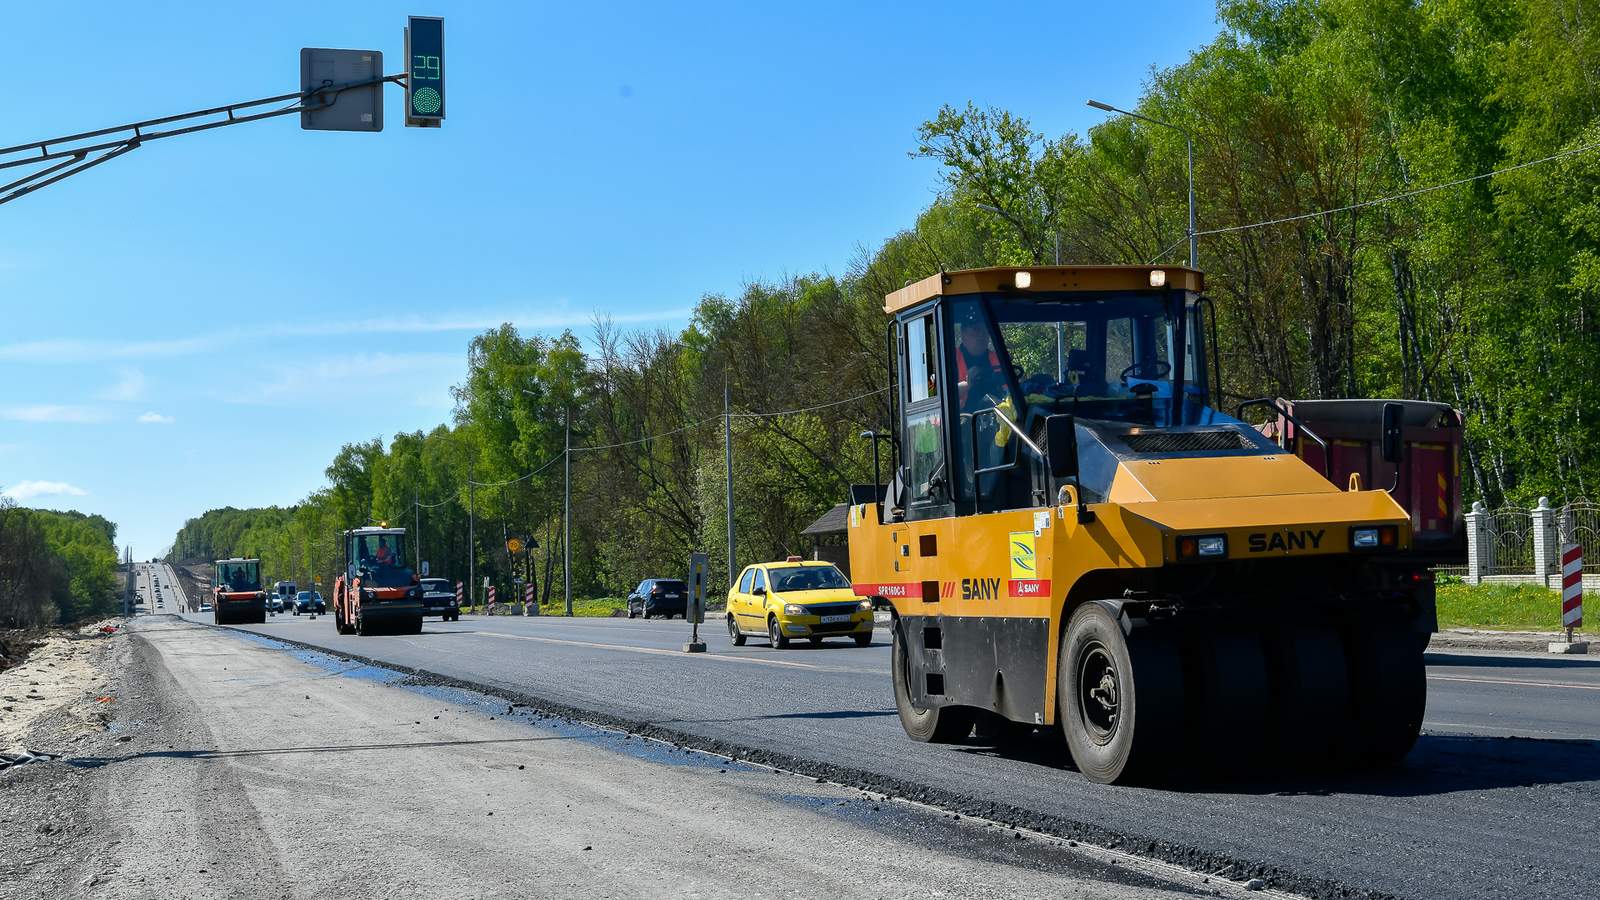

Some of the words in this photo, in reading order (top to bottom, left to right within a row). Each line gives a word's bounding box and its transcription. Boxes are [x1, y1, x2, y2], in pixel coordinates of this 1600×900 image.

[413, 55, 440, 80] 29
[1248, 529, 1326, 553] SANY
[961, 577, 1001, 601] SANY
[1024, 583, 1040, 593] SANY
